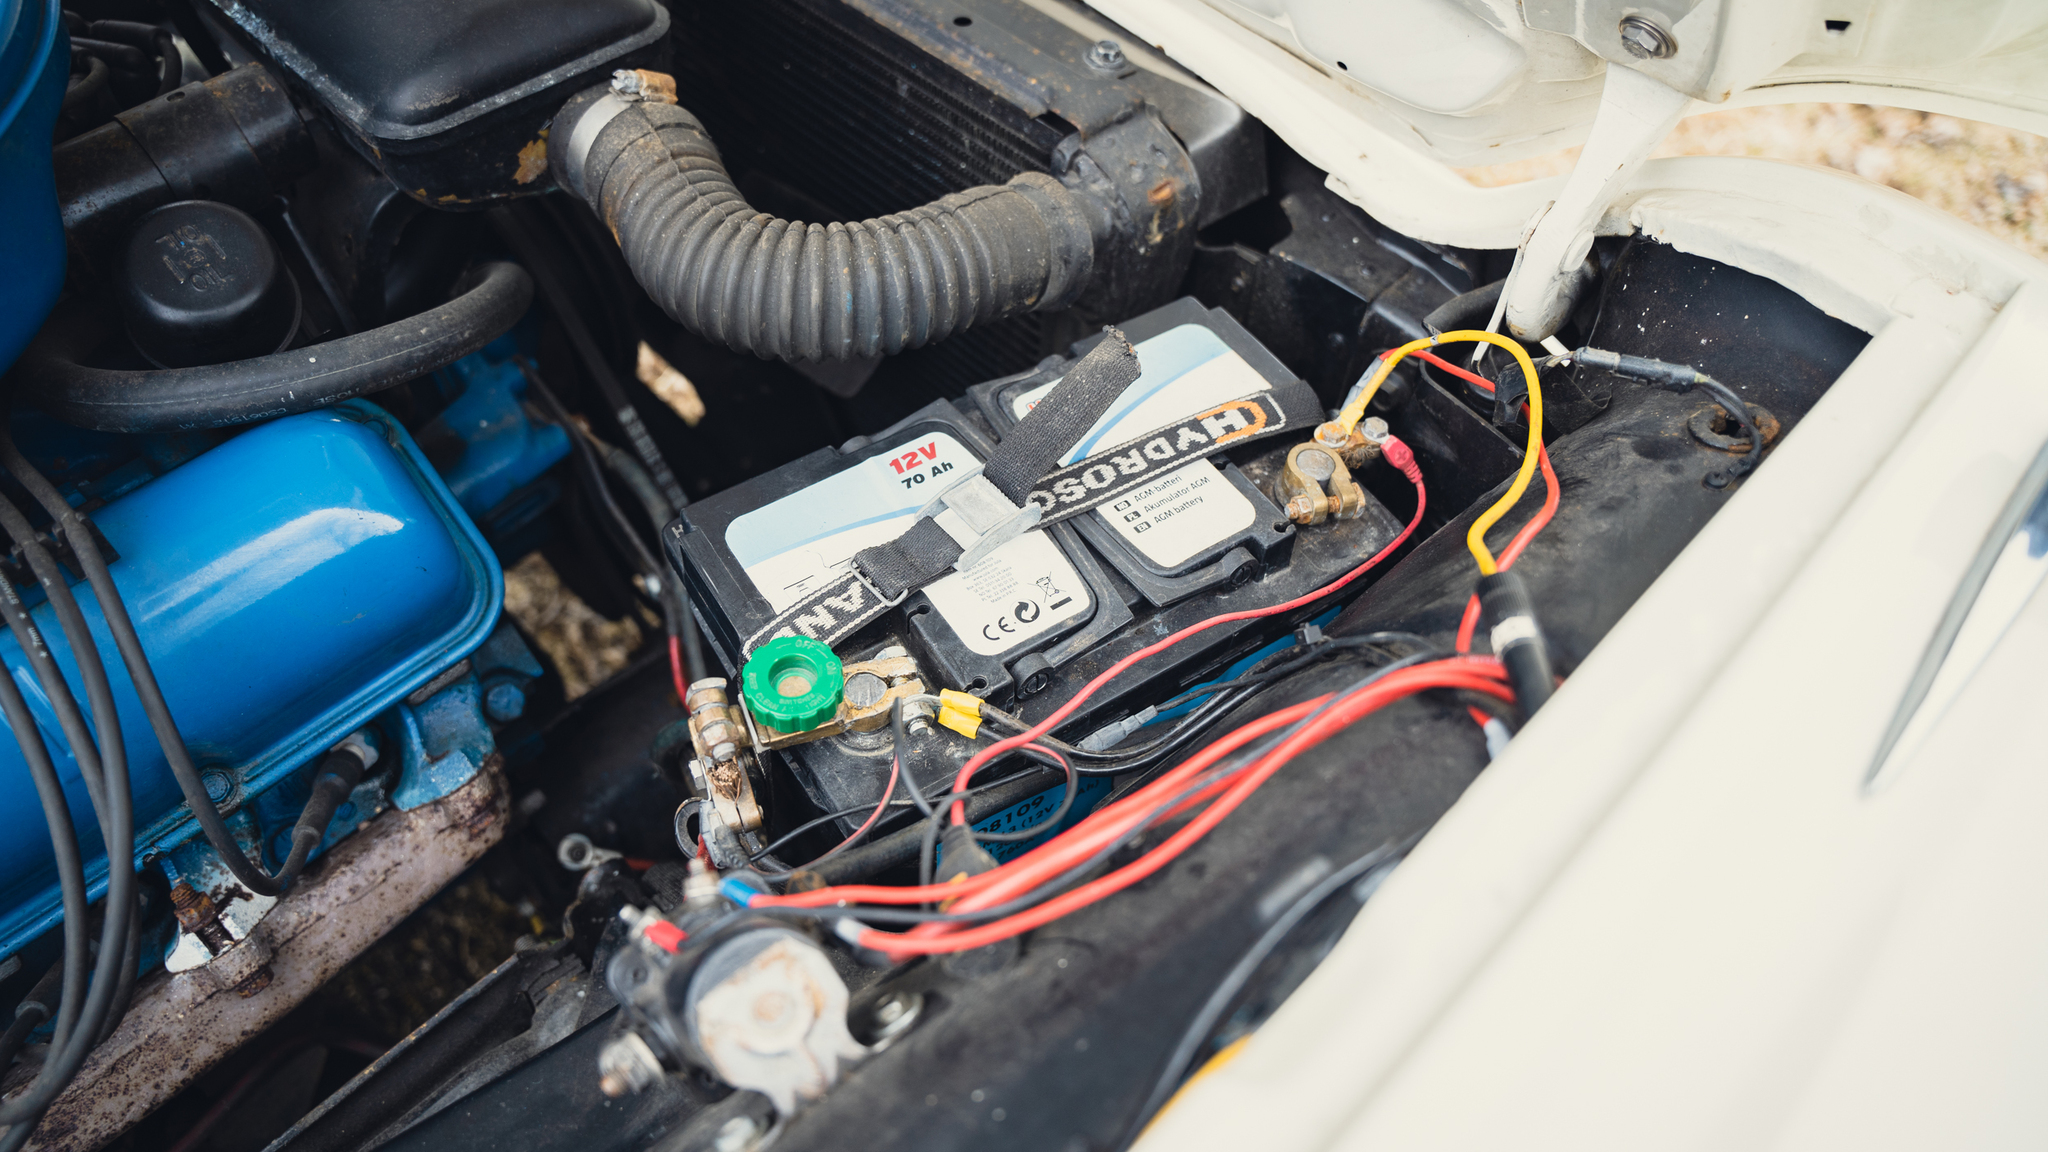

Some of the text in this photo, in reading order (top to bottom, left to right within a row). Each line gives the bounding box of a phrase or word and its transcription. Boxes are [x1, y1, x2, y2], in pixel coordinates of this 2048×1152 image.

[889, 442, 937, 475] 12V
[901, 461, 954, 490] 70 Ah
[1134, 474, 1183, 502] AGM-batteri
[1144, 487, 1190, 513] Akumulator
[1190, 476, 1211, 491] AGM
[1154, 509, 1175, 524] AGM
[1174, 495, 1204, 515] battery
[983, 616, 1015, 641] CE
[794, 639, 817, 650] OFF
[826, 661, 837, 676] ON
[755, 693, 779, 711] CLEAN
